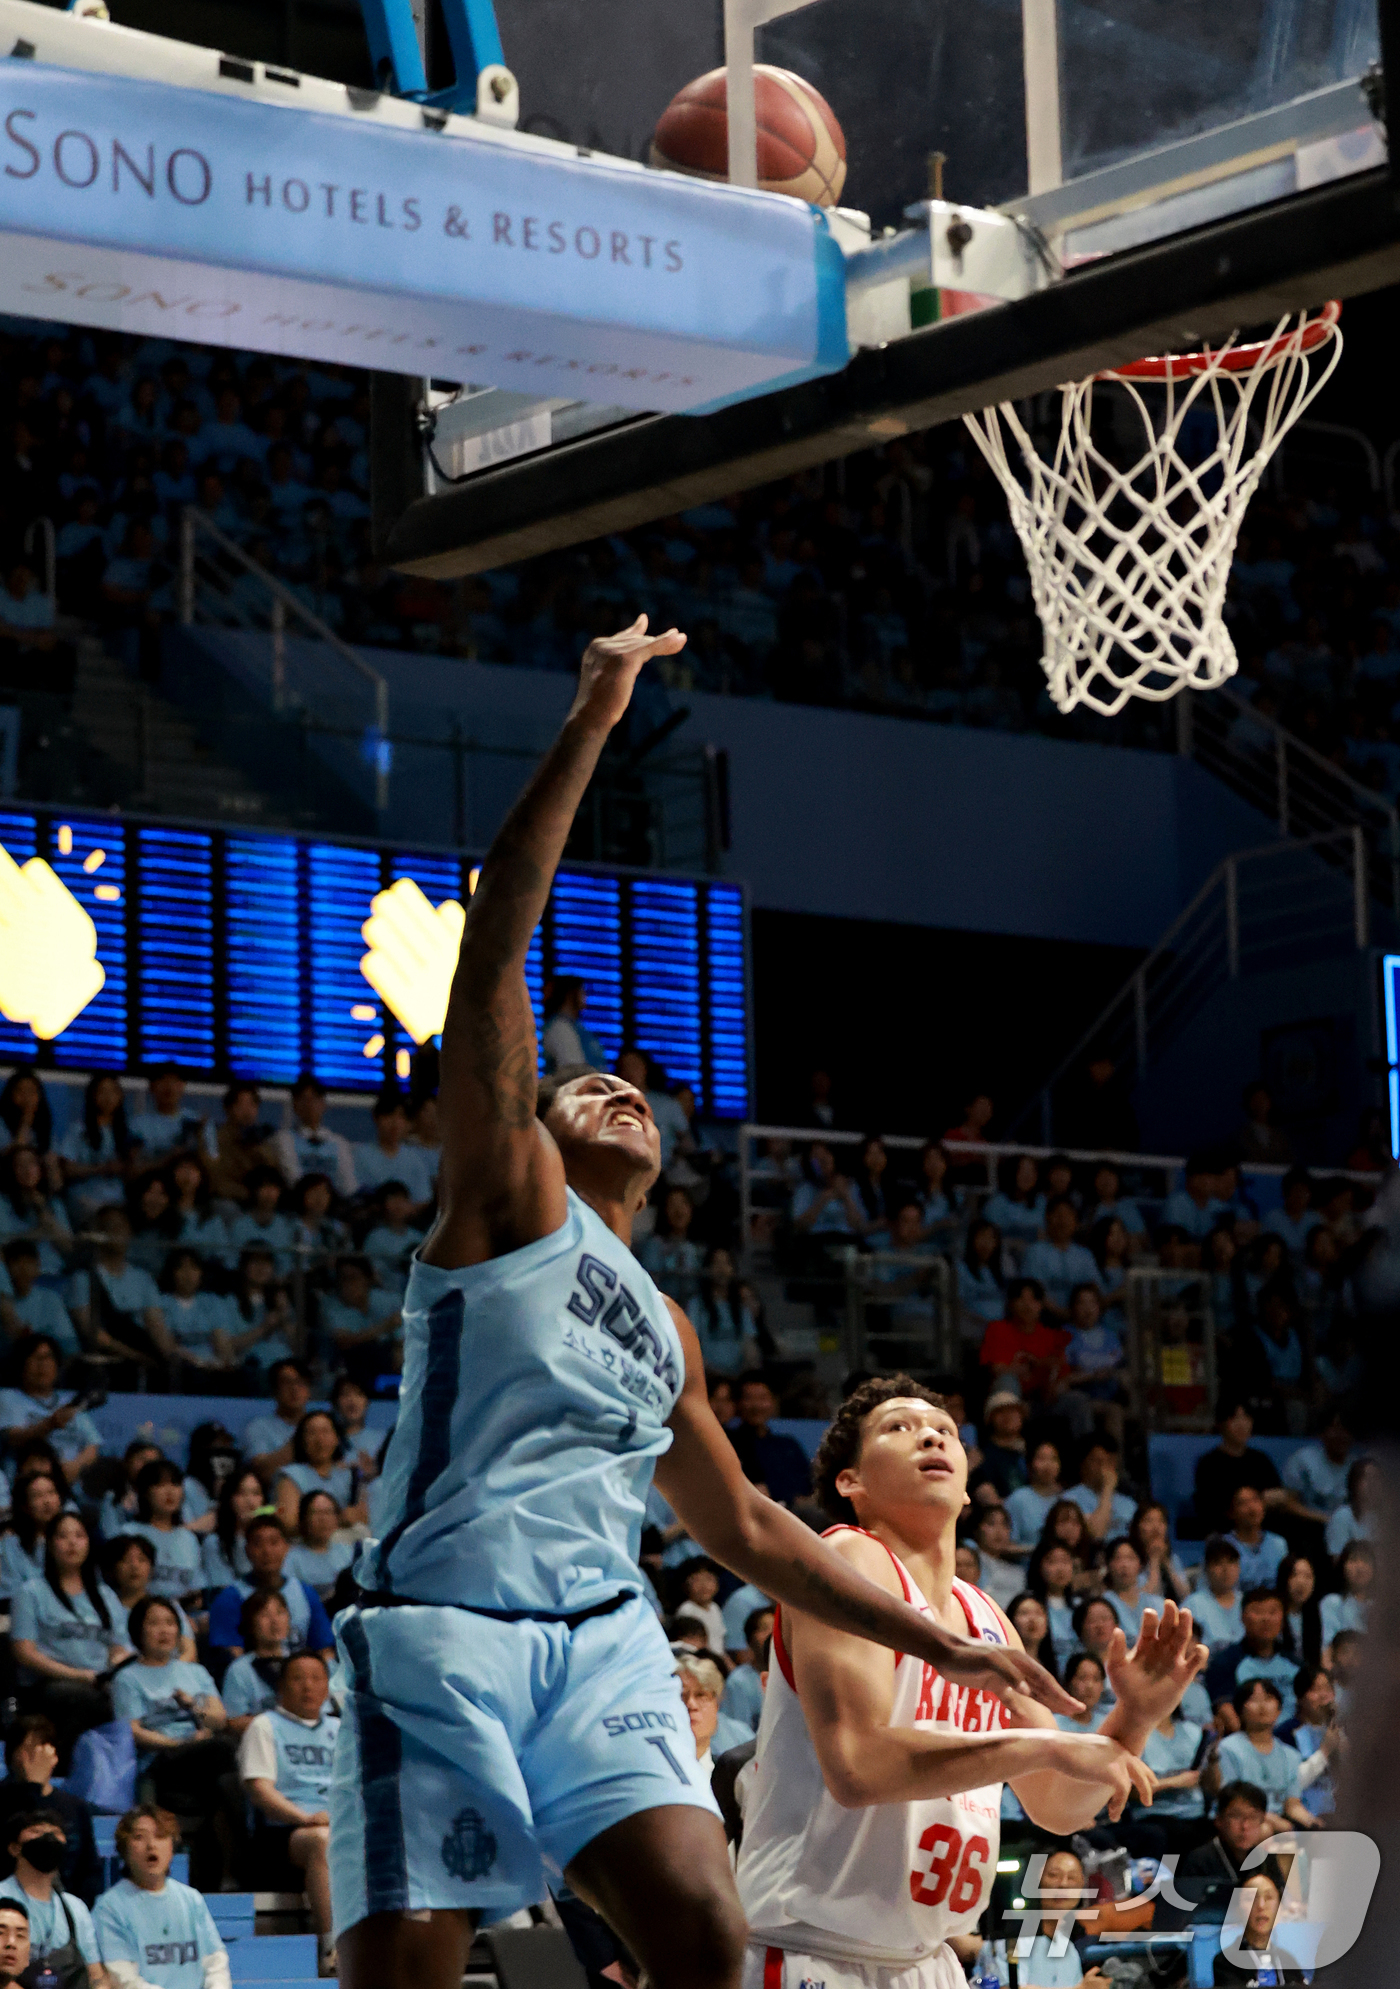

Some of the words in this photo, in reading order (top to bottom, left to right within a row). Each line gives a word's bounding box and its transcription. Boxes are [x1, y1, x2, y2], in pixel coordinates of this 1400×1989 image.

[5, 109, 212, 206] SONO
[245, 171, 422, 232] HOTELS
[444, 204, 470, 240] &
[492, 210, 684, 274] RESORTS
[20, 272, 242, 317] SONO
[644, 1735, 692, 1787] 1
[910, 1822, 990, 1914] 36
